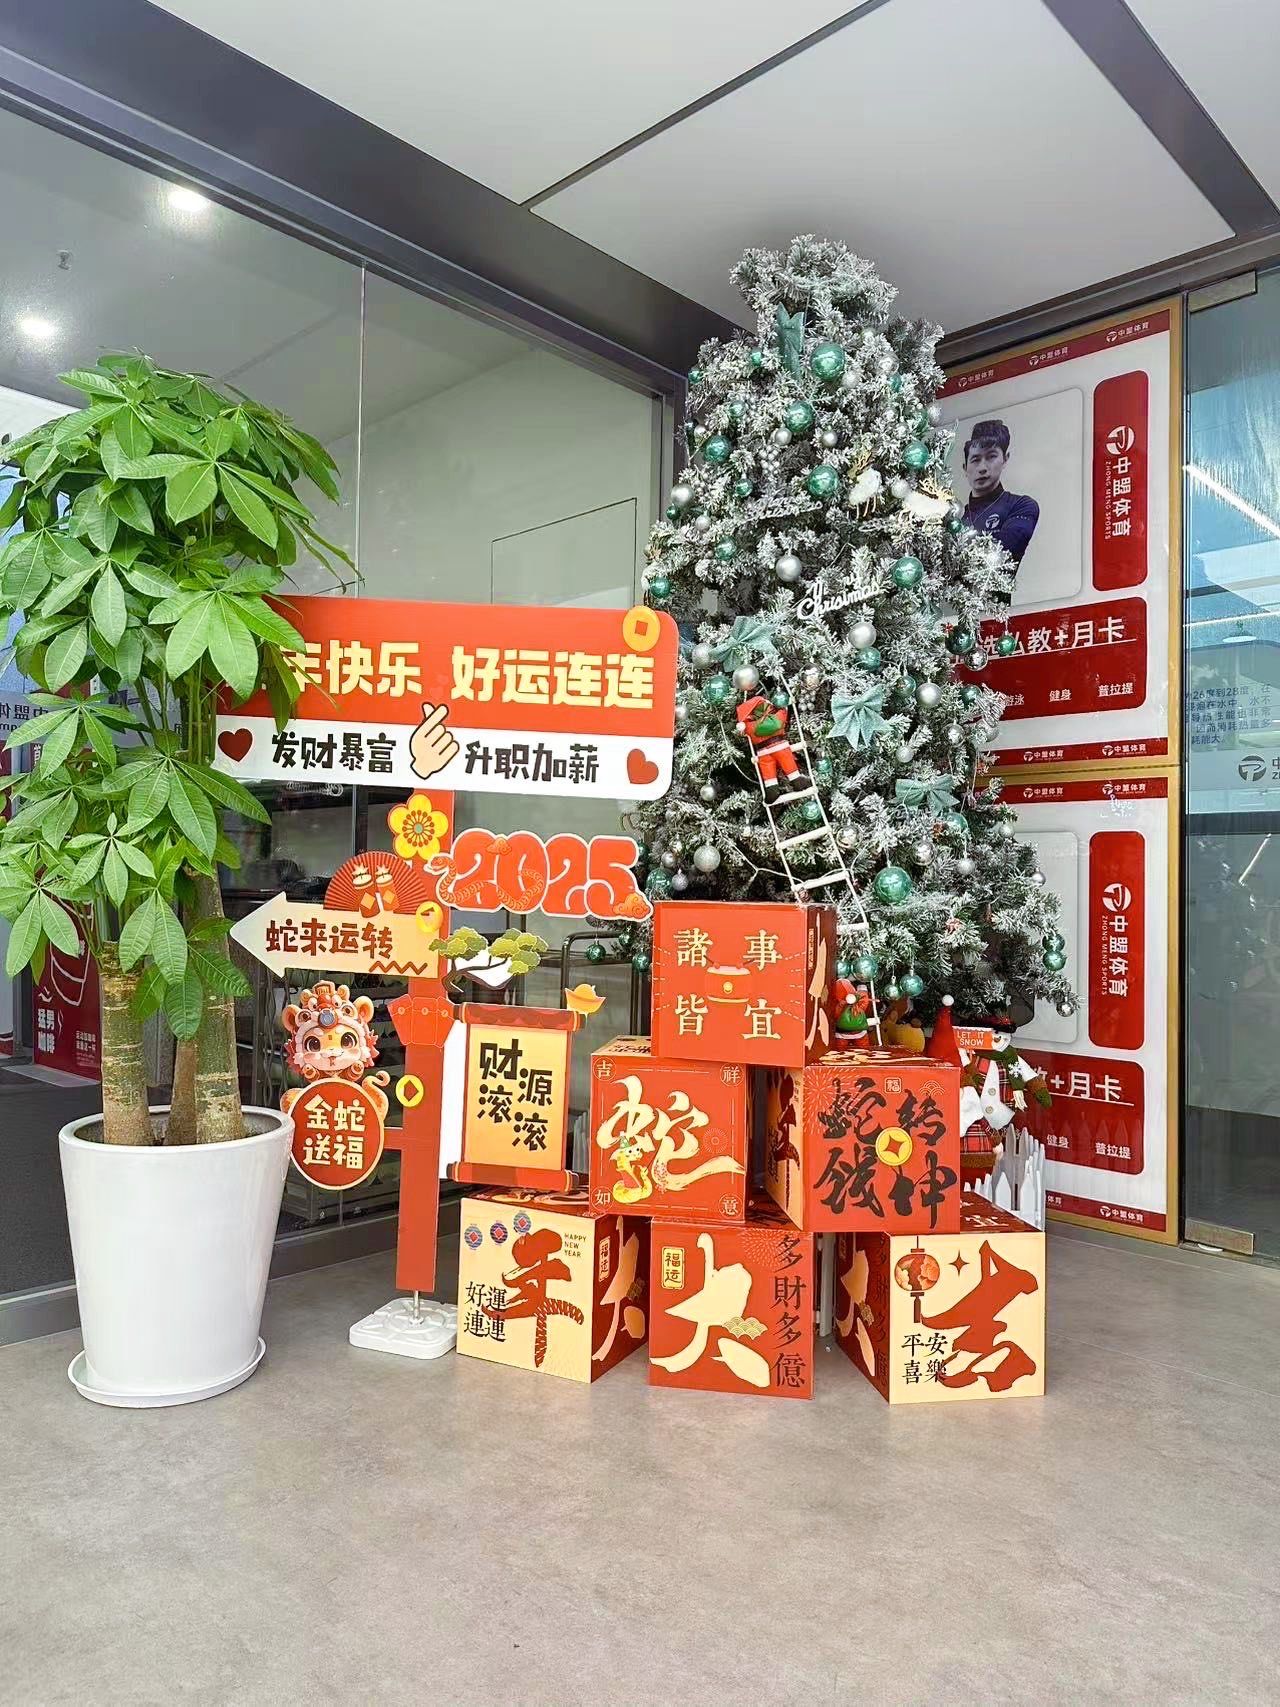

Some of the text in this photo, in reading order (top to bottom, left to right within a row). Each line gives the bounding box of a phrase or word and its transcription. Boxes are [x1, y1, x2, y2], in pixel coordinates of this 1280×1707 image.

[1117, 322, 1149, 337] 中盟体育
[1112, 457, 1131, 537] 中盟体育
[262, 640, 655, 709] 年快乐 好运连连
[1049, 689, 1072, 702] 健身
[1098, 682, 1134, 697] 普拉提
[1034, 750, 1063, 759] 中盟体育
[1114, 743, 1146, 753] 中盟体育
[271, 732, 599, 784] 发财暴富 升职加薪
[1034, 787, 1063, 796] 中盟体育
[1114, 783, 1146, 793] 中盟体育
[450, 828, 647, 919] 2025
[265, 918, 394, 959] 蛇来运转
[1109, 915, 1128, 997] 中盟体育
[674, 994, 782, 1040] 皆宜
[957, 1030, 985, 1039] LET IT
[479, 1038, 553, 1106] 财源
[596, 1060, 613, 1078] 吉
[722, 1066, 740, 1083] 祥
[304, 1094, 366, 1132] 金蛇
[477, 1084, 548, 1151] 滚滚
[1047, 1134, 1069, 1148] 健身
[303, 1132, 364, 1170] 送福
[1095, 1142, 1131, 1159] 普拉提
[595, 1190, 611, 1206] 如
[722, 1198, 739, 1215] 意
[1112, 1208, 1143, 1223] 中盟体育
[564, 1232, 587, 1242] HAPPY
[564, 1241, 579, 1250] NEW
[564, 1250, 582, 1258] YEAR
[664, 1252, 681, 1284] 福运
[464, 1280, 508, 1313] 好運
[769, 1234, 807, 1388] 多財多億
[901, 1333, 948, 1357] 平安
[901, 1360, 947, 1385] 喜樂
